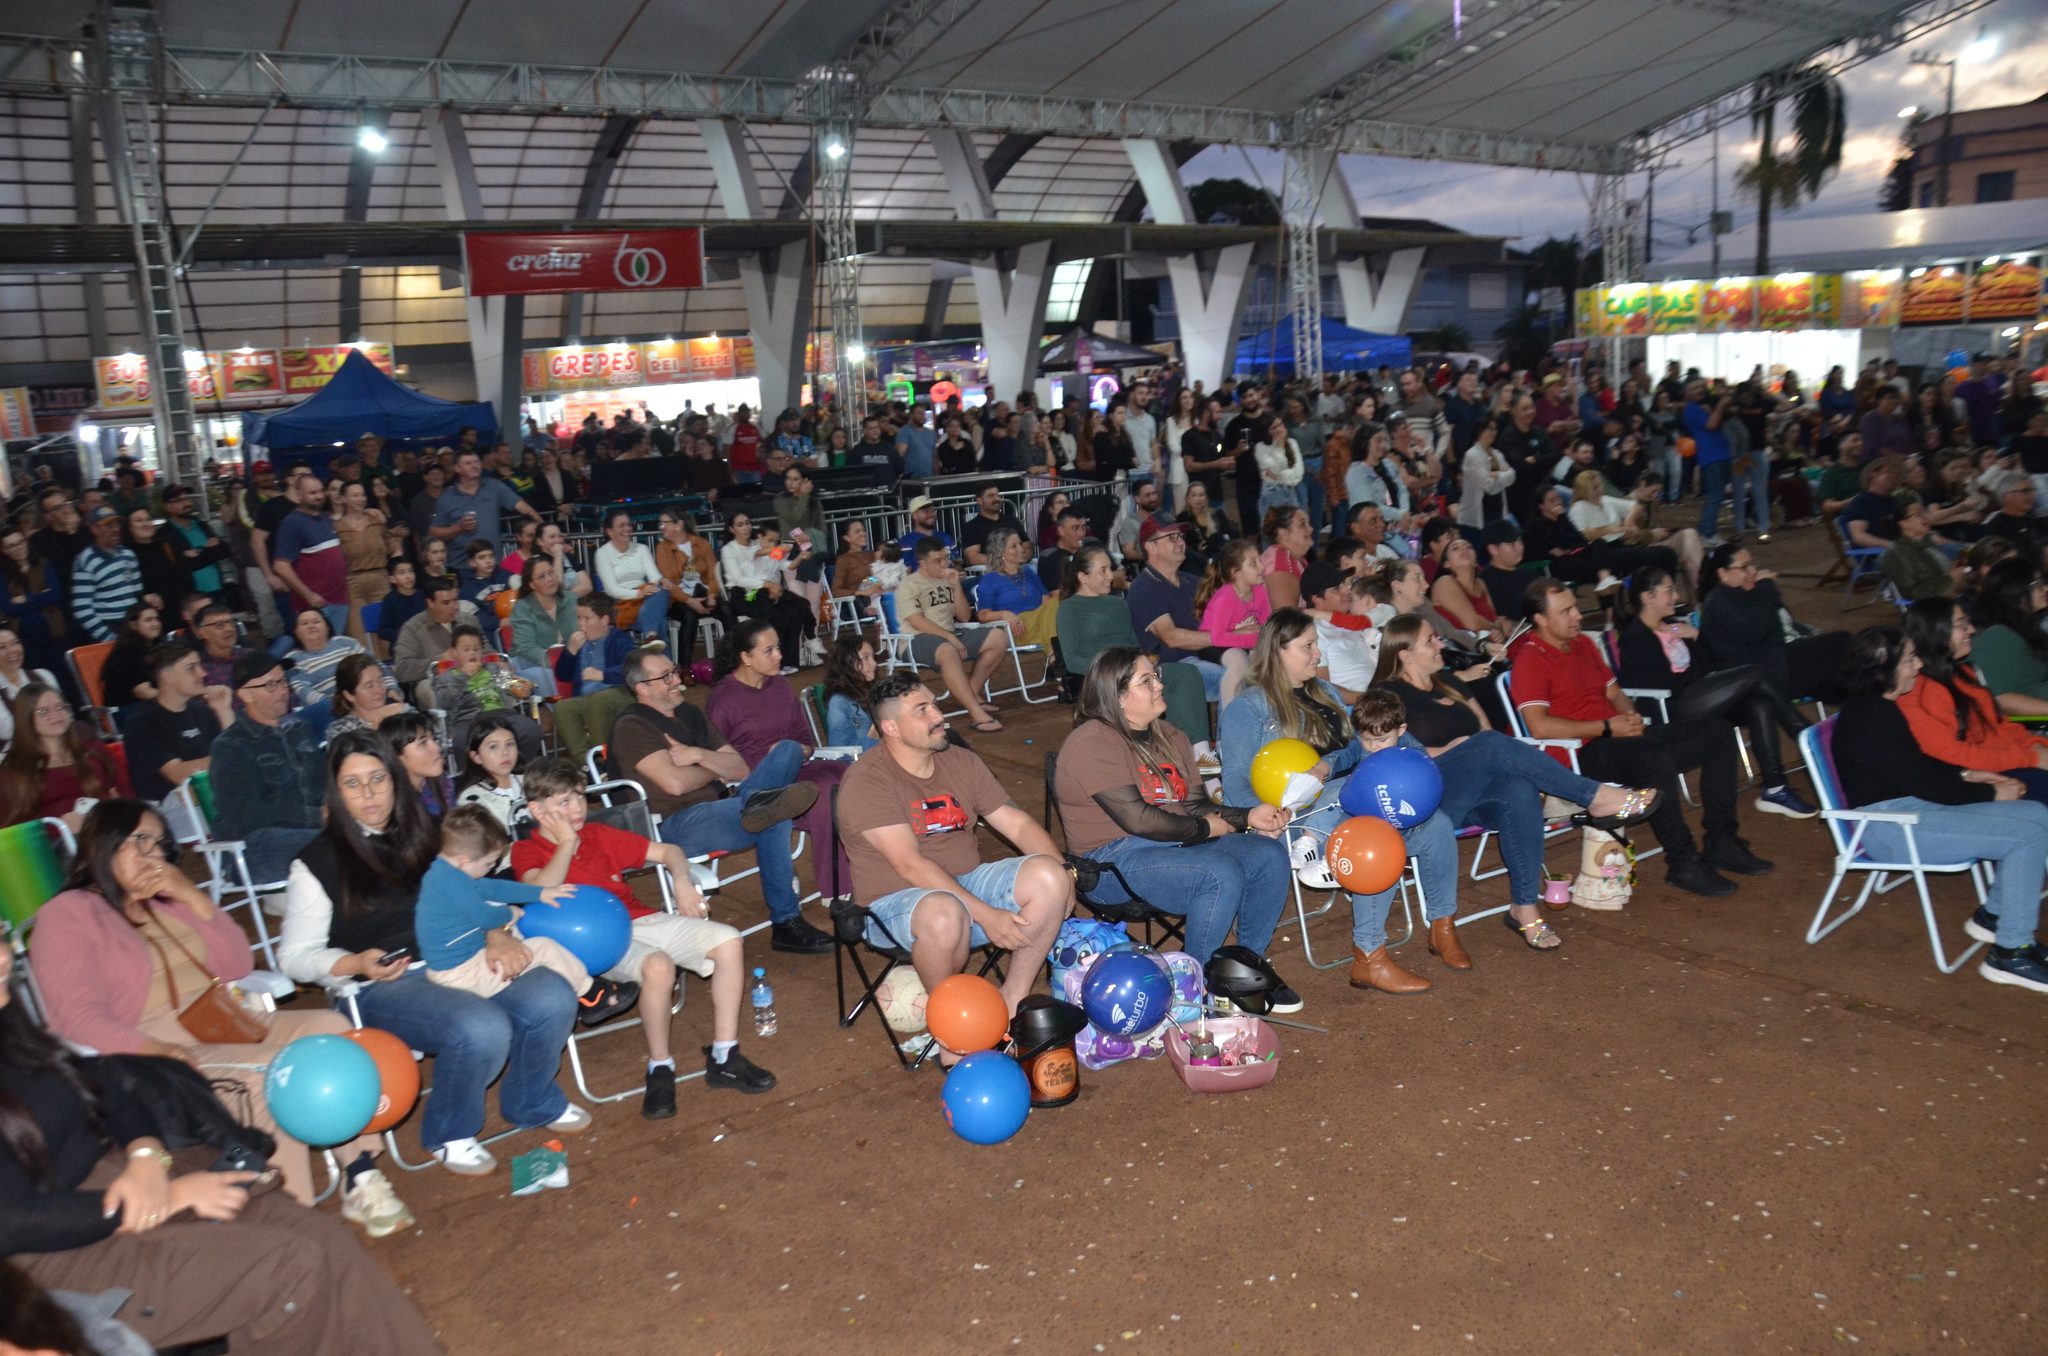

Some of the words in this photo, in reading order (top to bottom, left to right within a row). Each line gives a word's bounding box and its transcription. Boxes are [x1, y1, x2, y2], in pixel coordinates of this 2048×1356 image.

[230, 355, 274, 368] XIS
[551, 350, 638, 376] CREPES
[650, 358, 679, 373] REI
